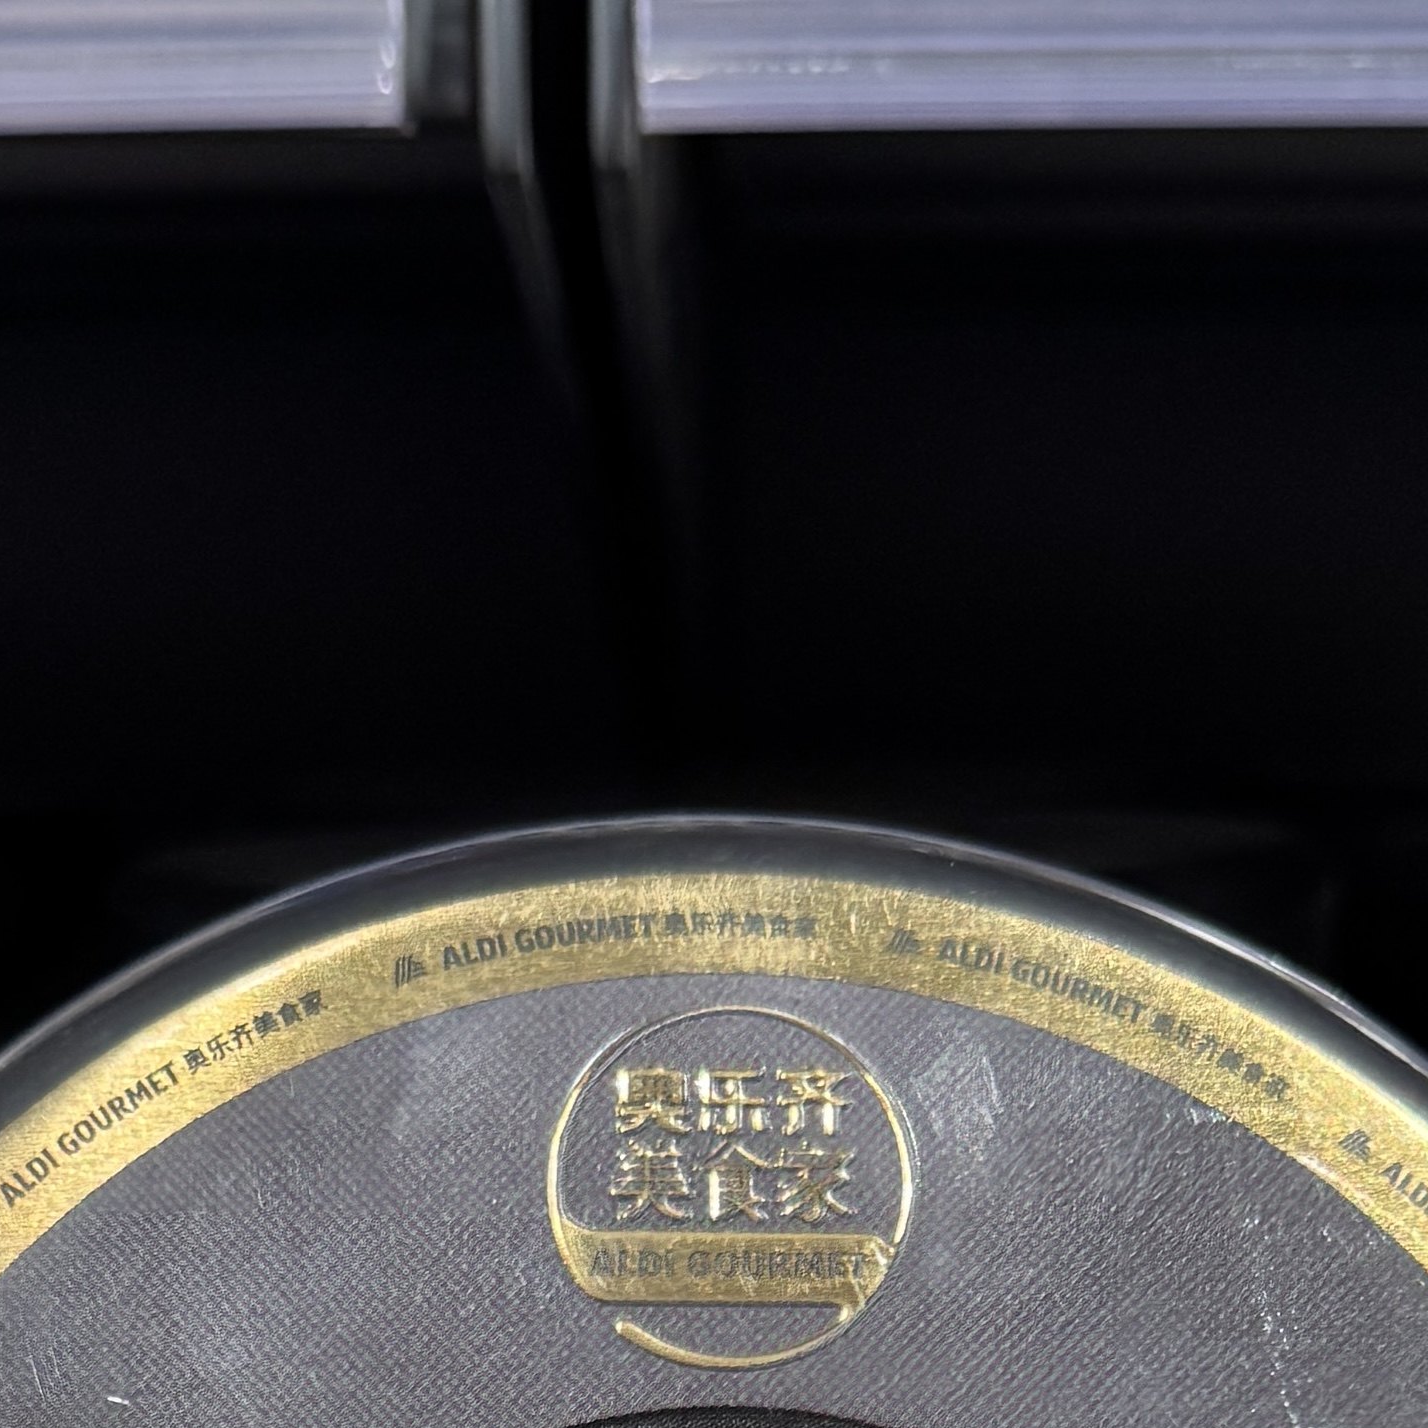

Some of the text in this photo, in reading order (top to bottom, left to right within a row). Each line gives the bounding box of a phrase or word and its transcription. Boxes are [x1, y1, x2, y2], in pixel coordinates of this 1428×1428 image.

[441, 935, 507, 971] ALDI
[515, 913, 654, 955] GOURMET
[937, 937, 1007, 978] ALDI
[1011, 958, 1147, 1025] GOURMET
[57, 1061, 180, 1156] GOURMET
[182, 990, 326, 1075] 奥乐齐美食家
[615, 1065, 853, 1137] 奥乐齐
[610, 1139, 857, 1222] 美食家
[590, 1249, 866, 1279] ALDI GOURMET
